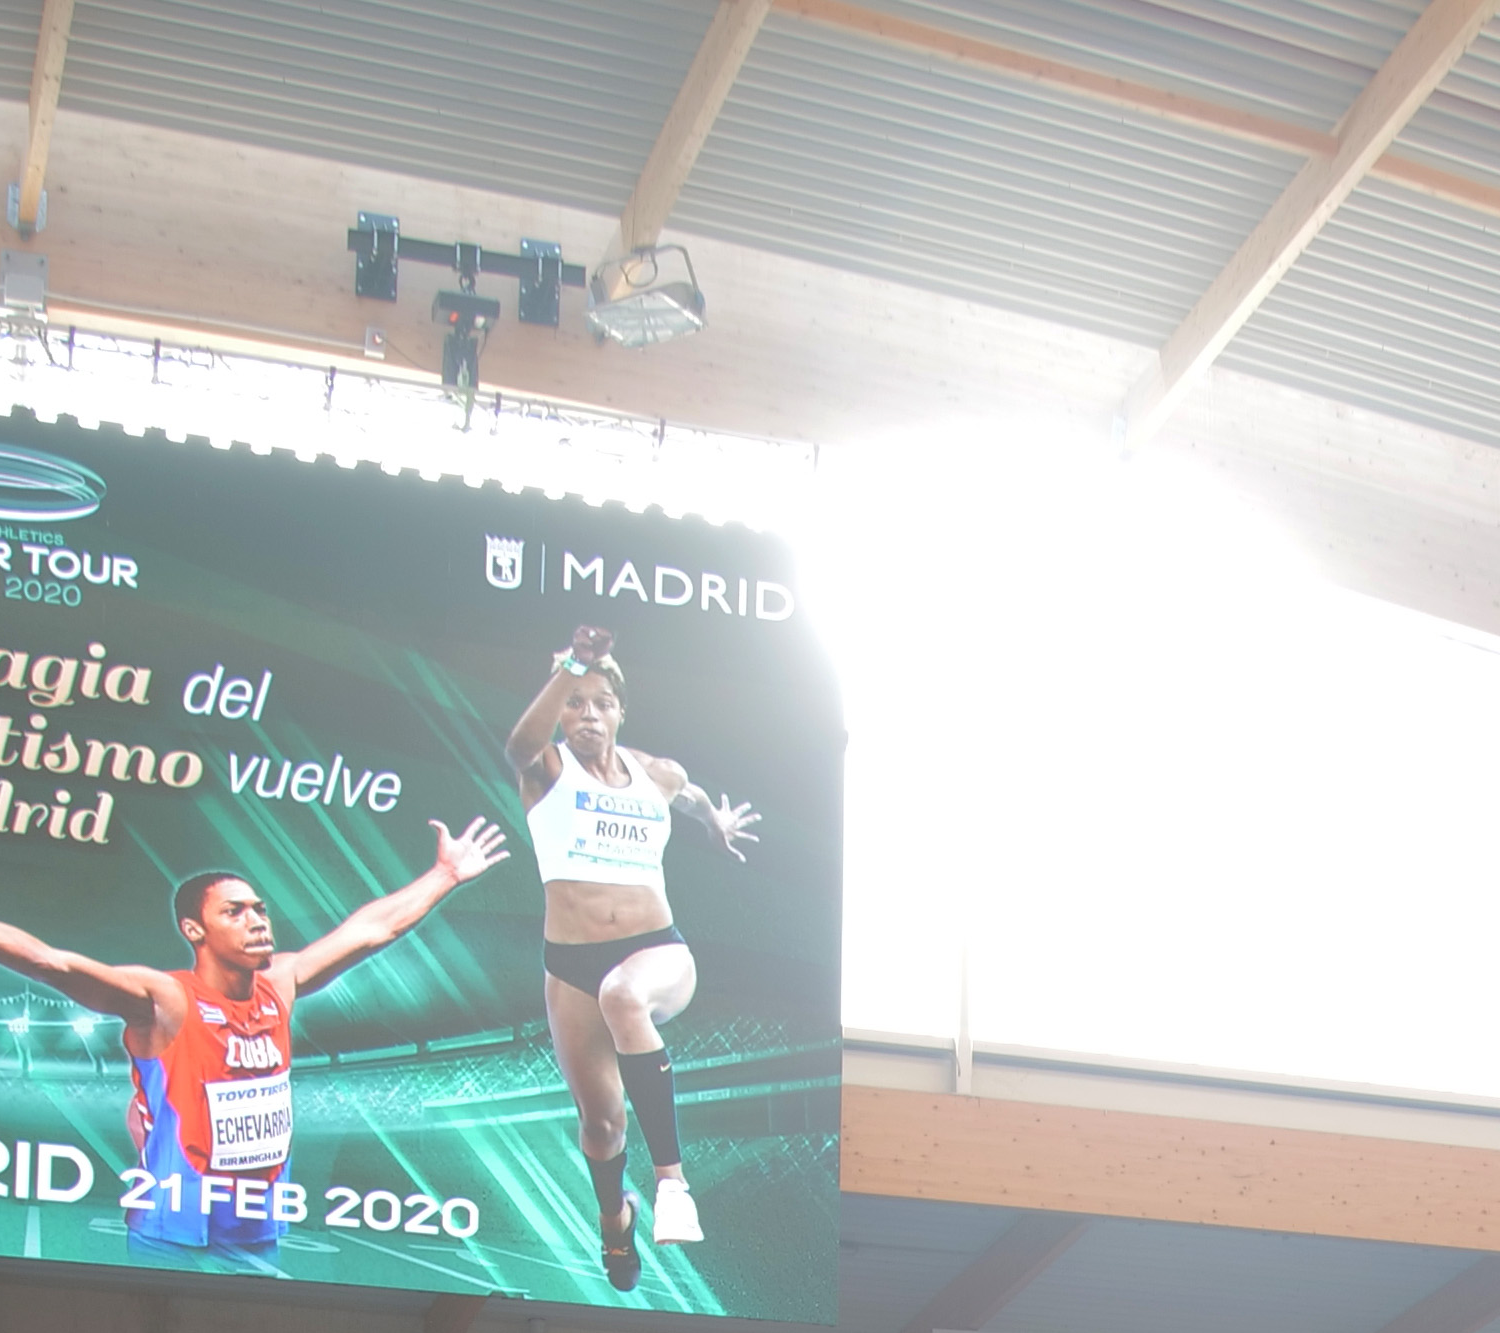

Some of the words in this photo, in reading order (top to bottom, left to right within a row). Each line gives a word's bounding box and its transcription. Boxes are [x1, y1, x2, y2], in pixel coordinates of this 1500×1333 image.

[22, 541, 138, 588] TOUR
[563, 551, 795, 622] MADRID
[5, 576, 82, 607] 2020
[183, 663, 273, 721] del
[229, 751, 403, 813] vuelve
[596, 820, 649, 843] ROJAS
[225, 1035, 283, 1069] CUBA
[119, 1168, 182, 1212] 21
[200, 1173, 308, 1223] FEB
[325, 1186, 480, 1239] 2020
